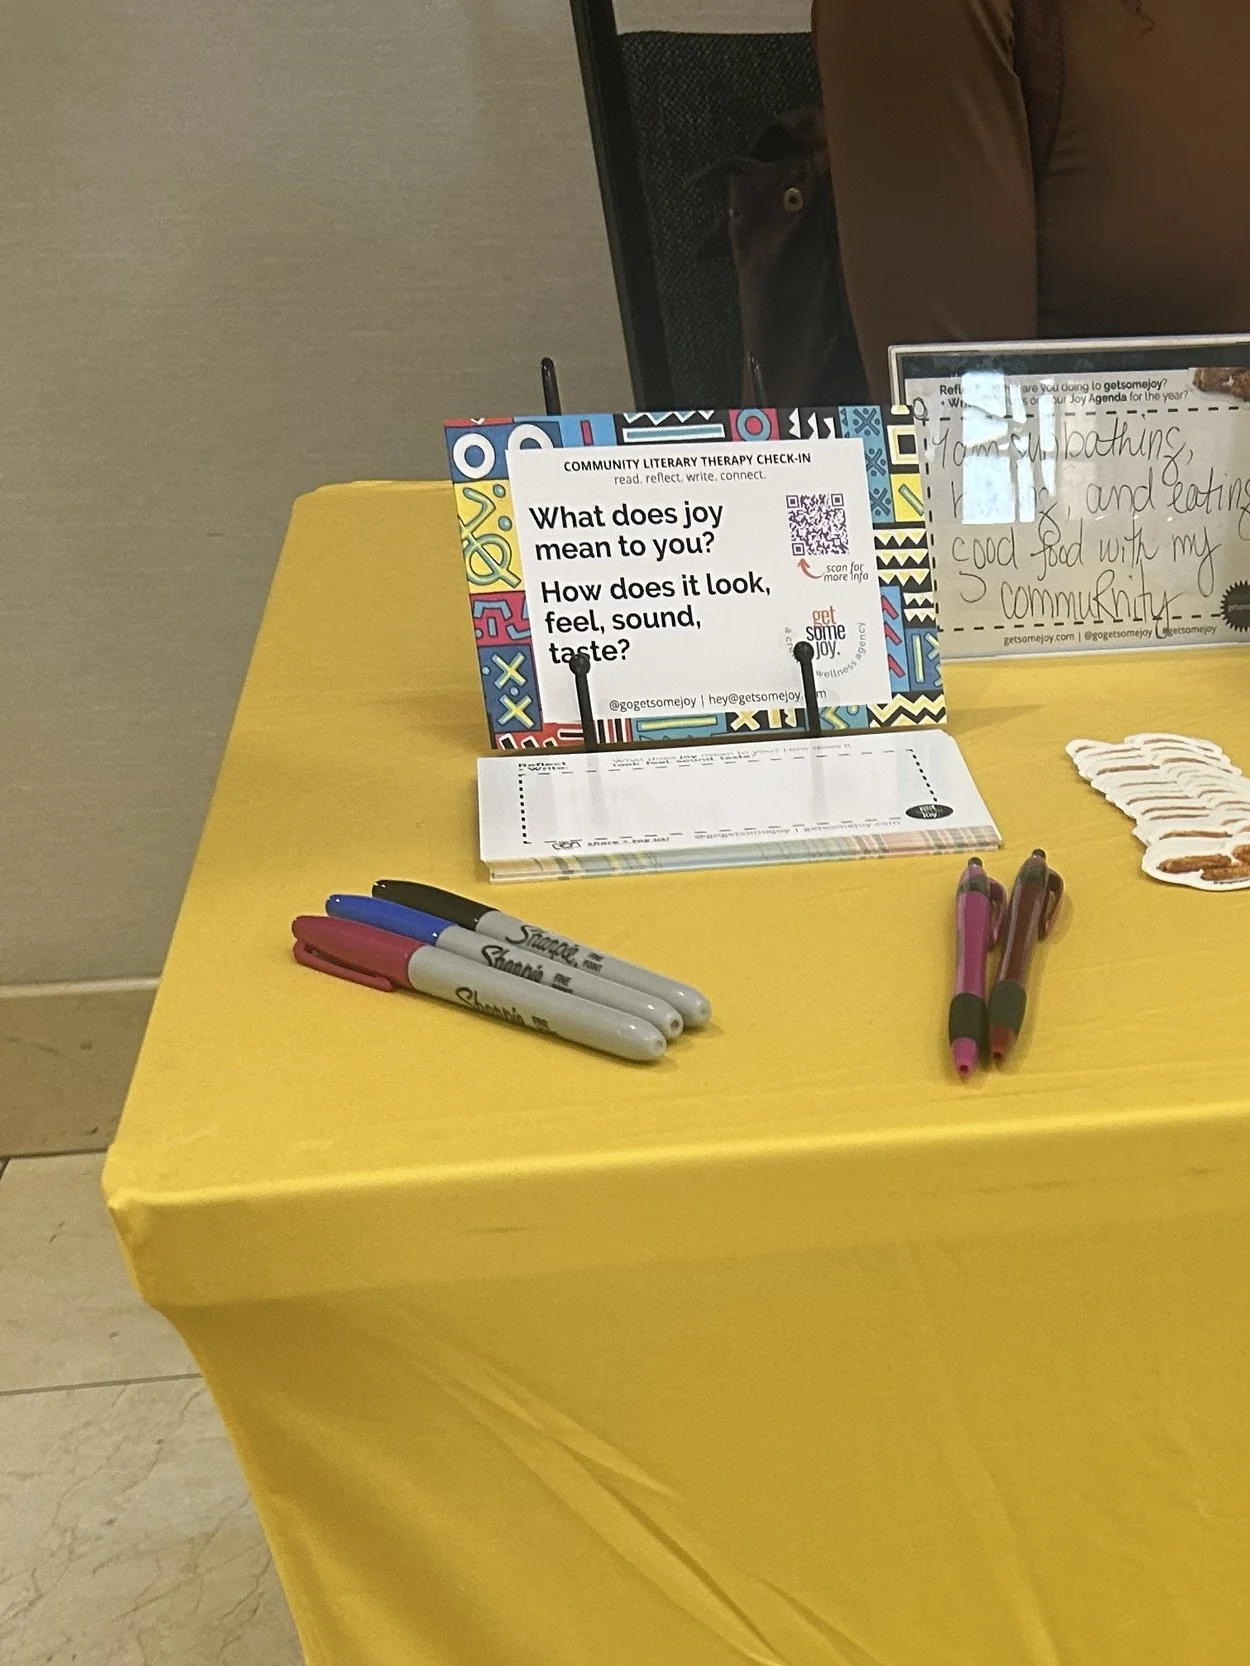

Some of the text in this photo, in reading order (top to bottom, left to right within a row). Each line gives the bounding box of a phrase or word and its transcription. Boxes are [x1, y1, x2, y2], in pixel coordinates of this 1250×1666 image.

[1022, 378, 1168, 396] are you doing to getsomejoy?
[1070, 394, 1086, 405] Joy
[1089, 393, 1127, 405] Agenda
[1129, 391, 1142, 401] for
[1144, 391, 1159, 401] the
[1162, 390, 1189, 402] year?
[564, 452, 812, 472] COMMUNITY LITERARY THERAPY CHECK-IN
[614, 470, 766, 485] read. reflect. write. connect.
[1086, 466, 1154, 514] and
[529, 501, 723, 530] What does joy
[535, 531, 715, 562] mean to you?
[1030, 518, 1083, 581] food
[1100, 511, 1160, 568] with
[1172, 526, 1223, 598] my
[824, 571, 869, 583] more info
[827, 562, 864, 575] scan for
[541, 571, 771, 604] How does it look,
[545, 605, 702, 634] feel, sound,
[813, 606, 837, 631] get
[806, 624, 846, 641] some
[1003, 631, 1075, 646] getsomejoy.com
[1084, 628, 1152, 642] @gogetsomejoy
[816, 640, 840, 660] joy.
[609, 696, 697, 713] @gogetsomejoy
